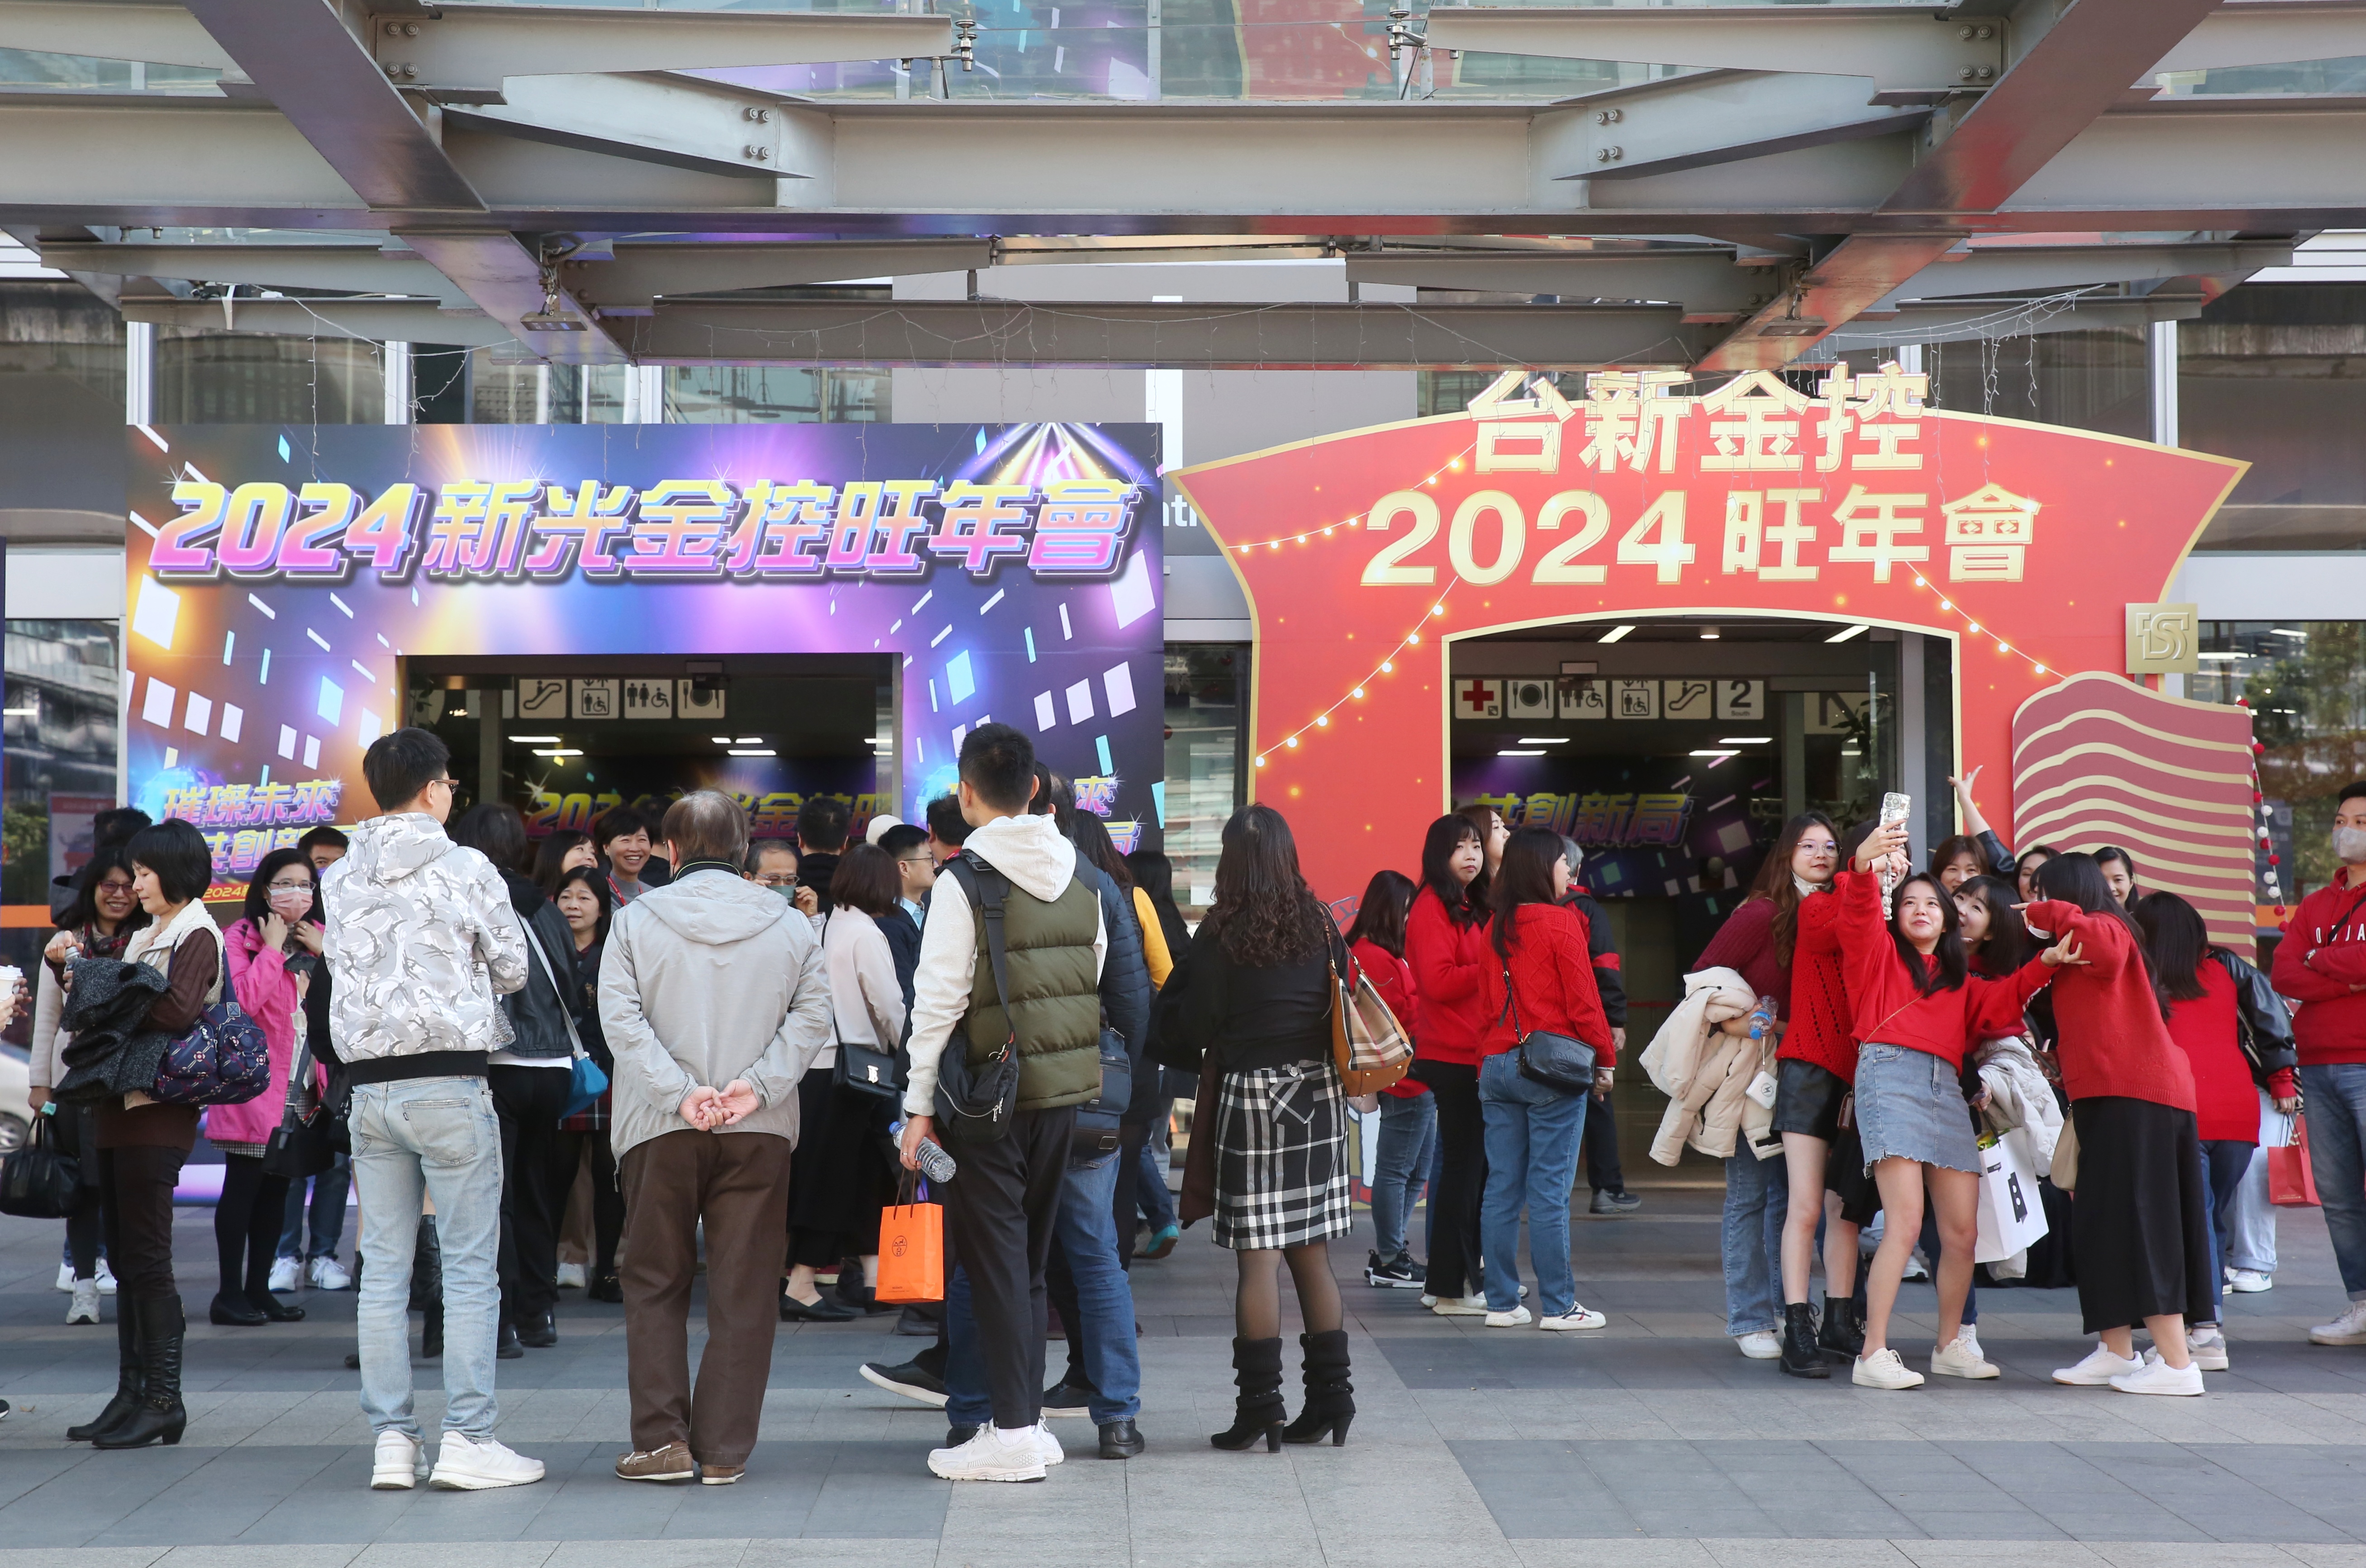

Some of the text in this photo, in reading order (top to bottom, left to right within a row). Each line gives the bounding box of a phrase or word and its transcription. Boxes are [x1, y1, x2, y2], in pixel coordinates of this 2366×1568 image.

[1468, 361, 1930, 474] 台新金控
[1730, 680, 1751, 708] 2
